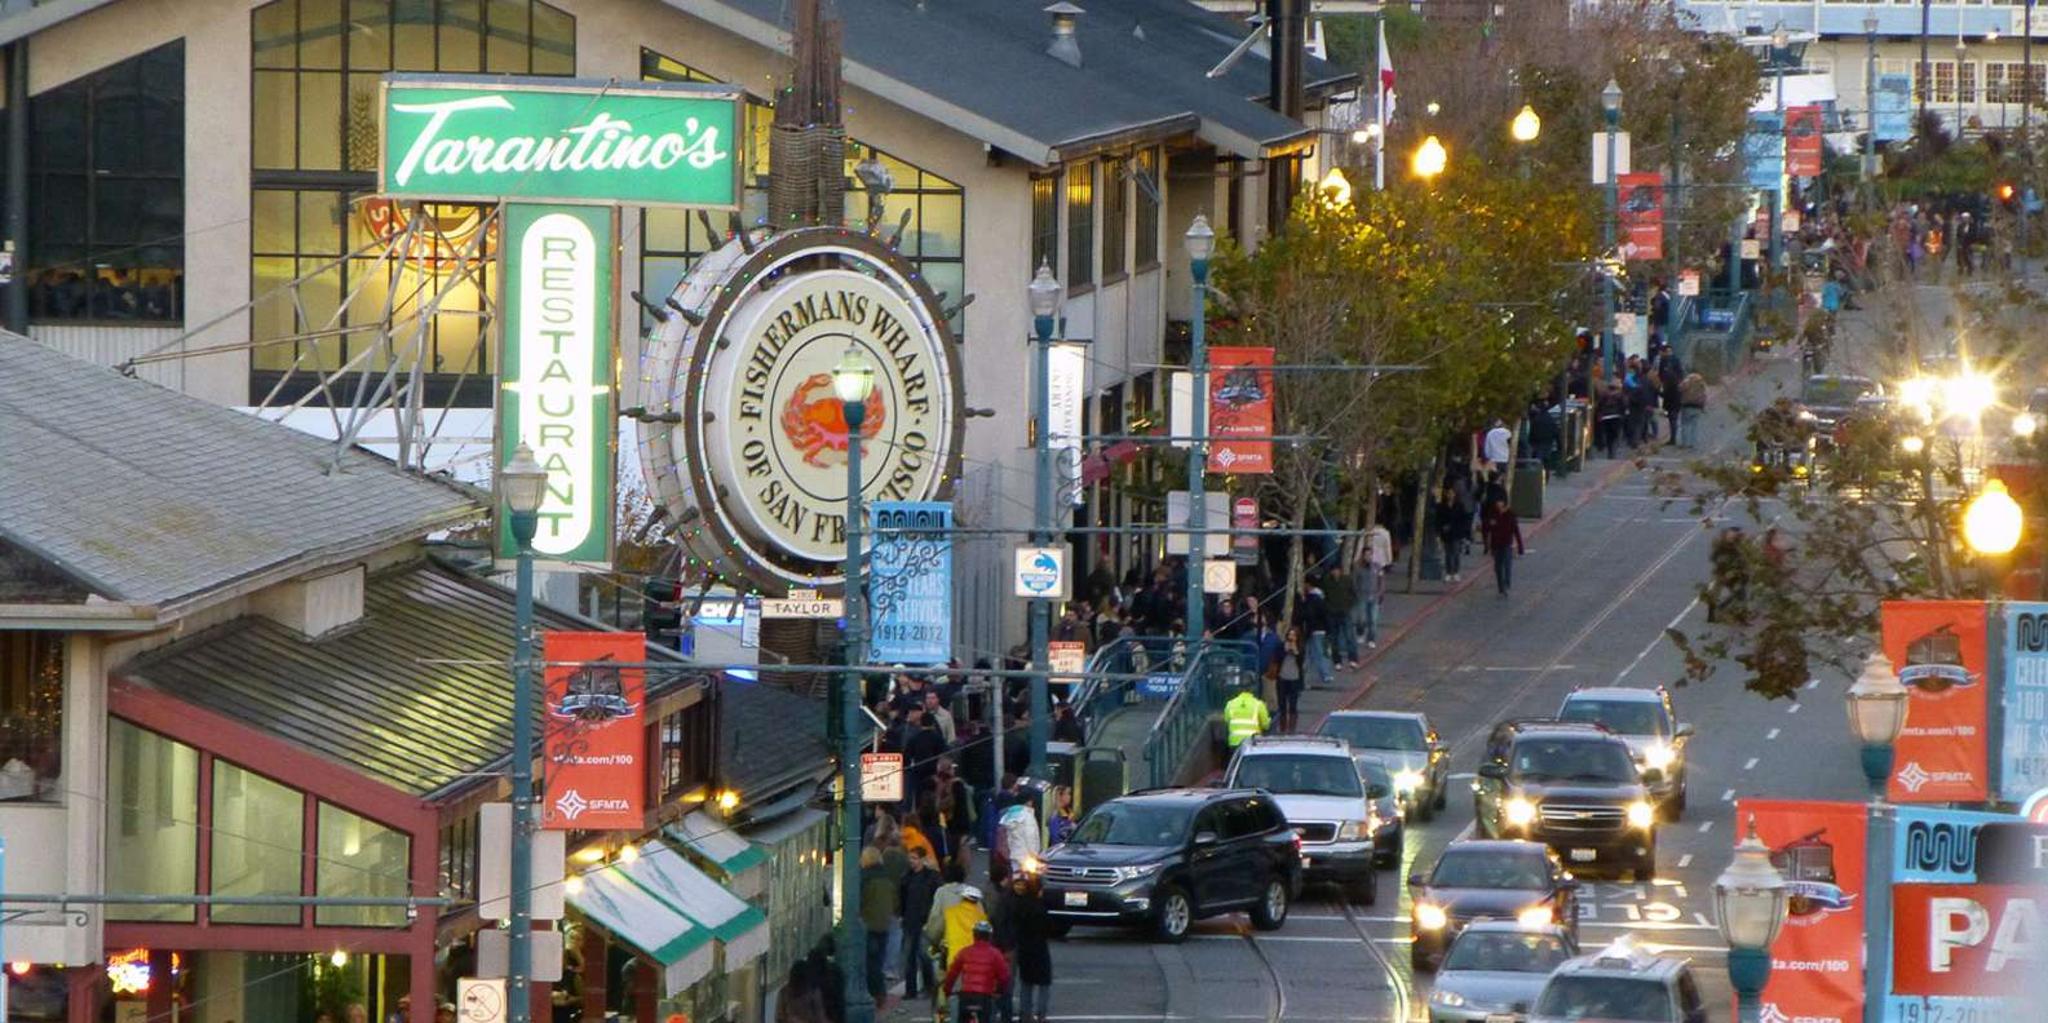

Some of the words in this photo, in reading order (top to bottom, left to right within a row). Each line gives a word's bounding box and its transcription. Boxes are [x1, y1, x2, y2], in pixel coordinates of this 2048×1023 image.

[392, 95, 727, 187] Tarantino's
[739, 289, 869, 421] FISHERMANS
[869, 303, 930, 419] WHARF
[537, 237, 577, 537] RESTAURANT
[742, 439, 773, 479] OF
[759, 479, 808, 536] SAN
[775, 604, 831, 613] TAYLOR
[878, 624, 944, 640] 1912-2012
[1931, 772, 1974, 782] SFMTA
[588, 799, 630, 811] SFMTA
